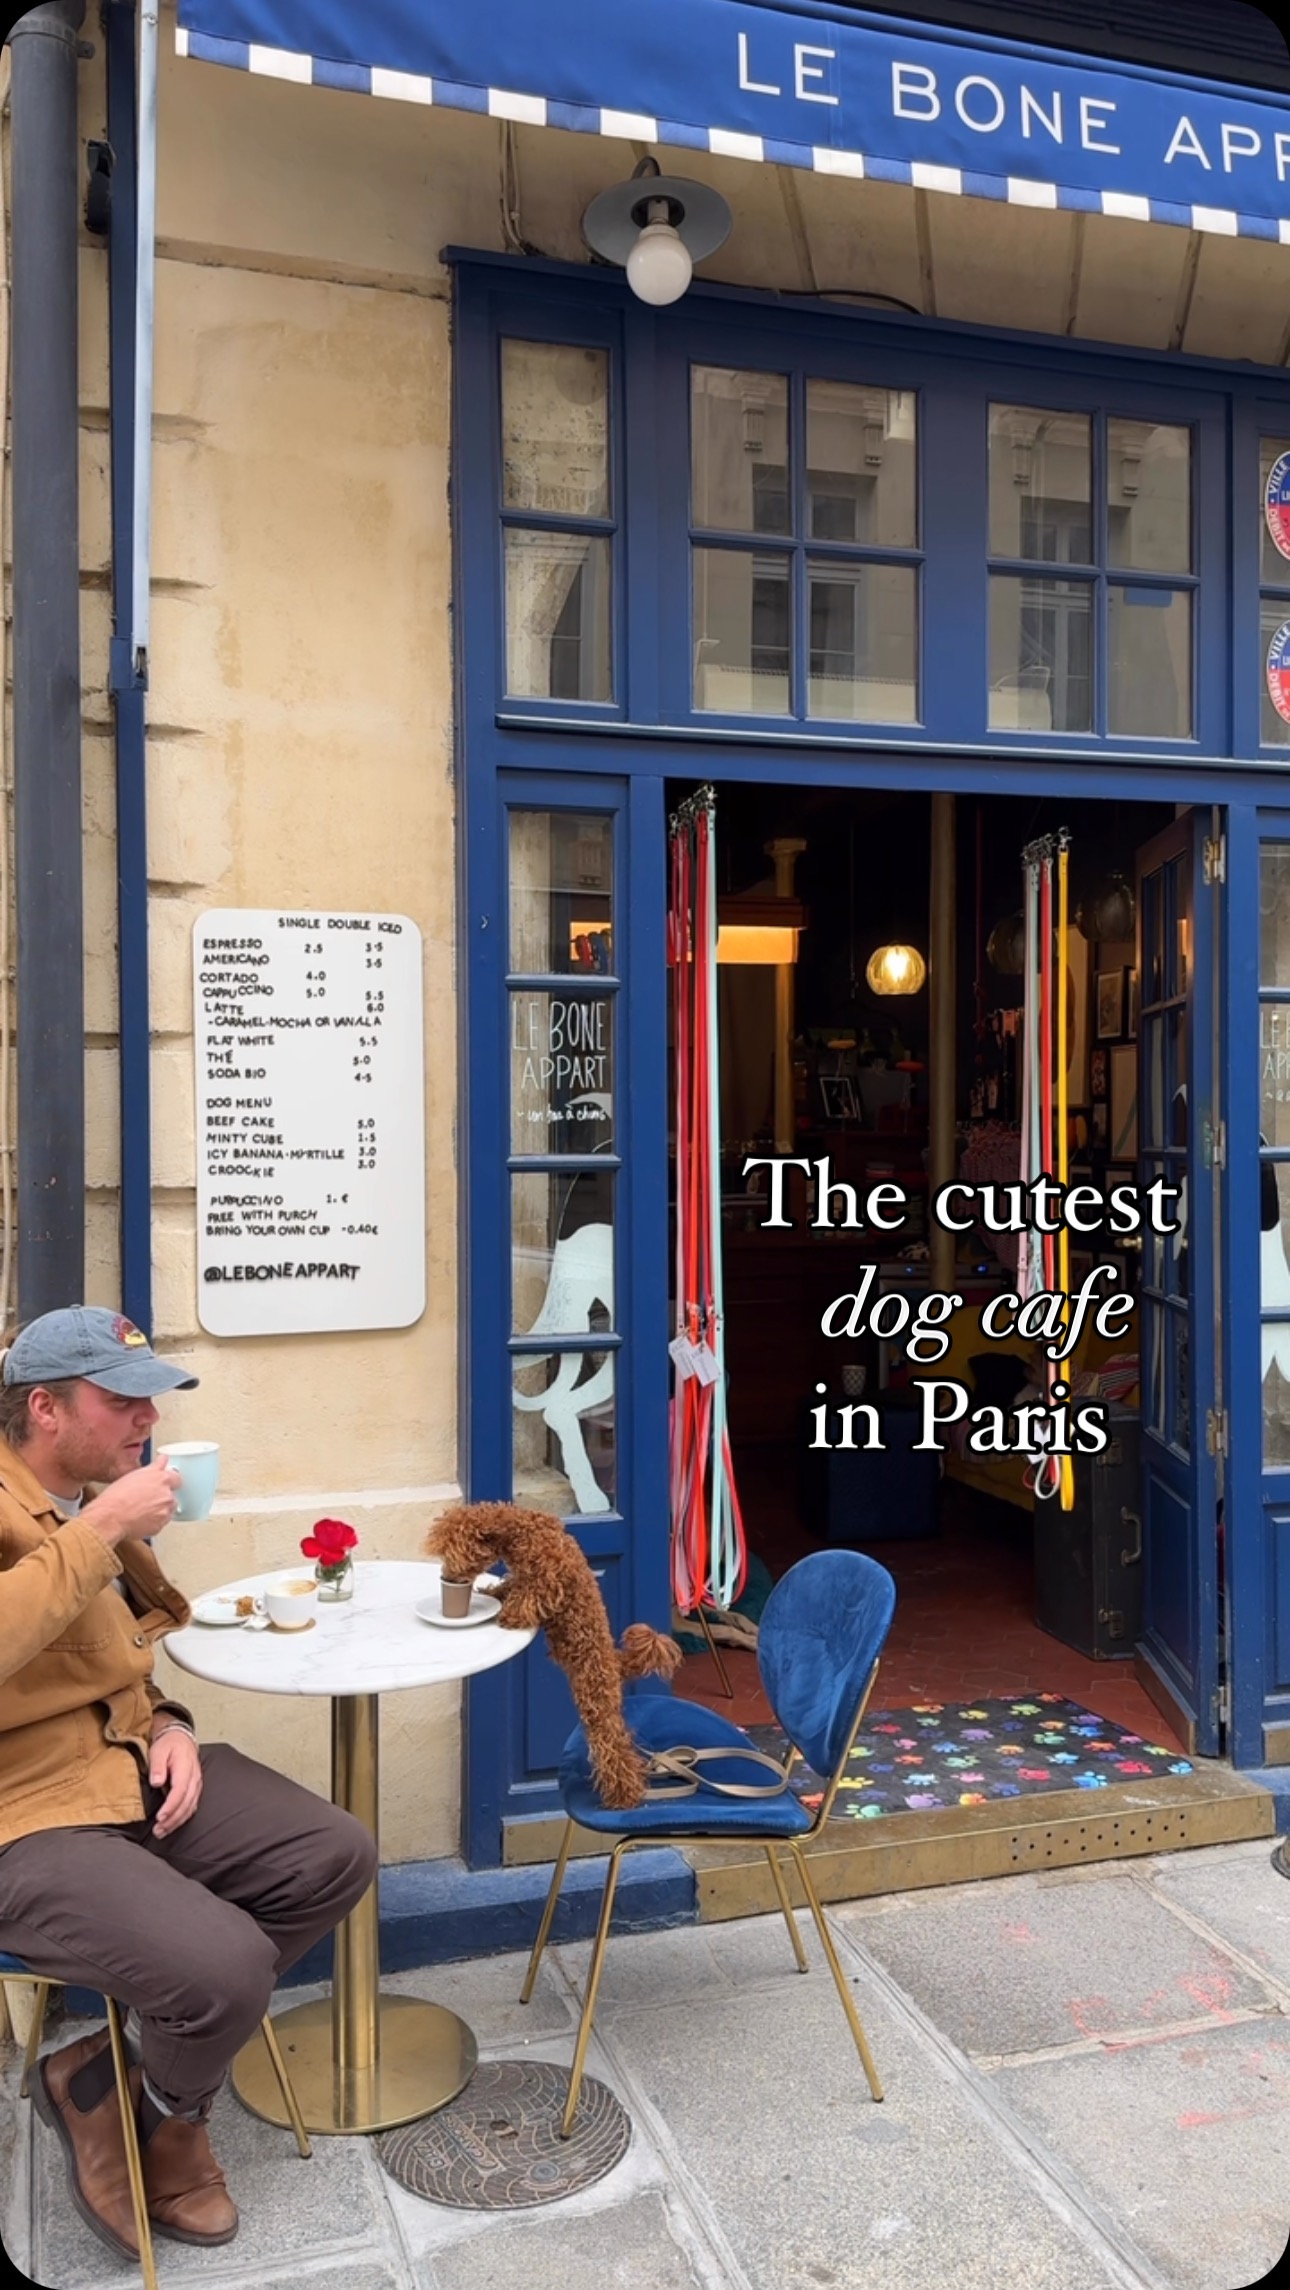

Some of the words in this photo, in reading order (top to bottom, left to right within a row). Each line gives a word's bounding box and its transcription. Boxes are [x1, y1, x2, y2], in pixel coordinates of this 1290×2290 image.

[738, 32, 839, 106] LE
[892, 62, 1120, 154] BONE
[279, 918, 319, 928] SINGLE
[328, 919, 370, 930] DOUBLE
[378, 923, 402, 934] ICED
[203, 939, 262, 949] ESPRESSO
[305, 944, 322, 953] 2.5
[203, 954, 269, 966] AMERICANO
[199, 973, 258, 983] CORTADO
[307, 971, 326, 980] 4.0
[203, 985, 274, 999] CAPPUCCINO
[307, 987, 325, 998] 5.0
[366, 991, 383, 1000] 5.5
[205, 1002, 244, 1015] LATTE
[367, 1003, 384, 1012] 6.0
[315, 1017, 330, 1027] OR
[513, 1000, 539, 1050] LE
[550, 1002, 606, 1052] BONE
[208, 1036, 233, 1045] FLAT
[238, 1035, 274, 1045] WHITE
[360, 1037, 377, 1046] 5.5
[207, 1050, 232, 1064] THÉ
[353, 1055, 370, 1066] 5.0
[208, 1068, 240, 1079] SODA
[245, 1068, 266, 1078] BIO
[522, 1055, 606, 1089] APPART
[206, 1097, 231, 1108] DOG
[236, 1098, 272, 1108] MENU
[207, 1116, 234, 1126] BEEF
[242, 1117, 274, 1127] CAKE
[358, 1118, 374, 1129] 5.0
[206, 1133, 247, 1143] MINTY
[252, 1134, 283, 1145] CUBE
[359, 1133, 375, 1142] 1.5
[208, 1149, 228, 1159] ICY
[359, 1147, 376, 1156] 3.0
[208, 1165, 274, 1177] CROOCKIE
[358, 1159, 375, 1169] 3.0
[208, 1212, 233, 1222] FREE
[242, 1210, 272, 1220] WITH
[278, 1210, 317, 1221] PURCH
[206, 1226, 242, 1236] BRING
[246, 1225, 275, 1236] YOUR
[278, 1225, 305, 1236] OWN
[309, 1226, 330, 1235] CUP
[204, 1262, 360, 1283] @LEBONEAPPART
